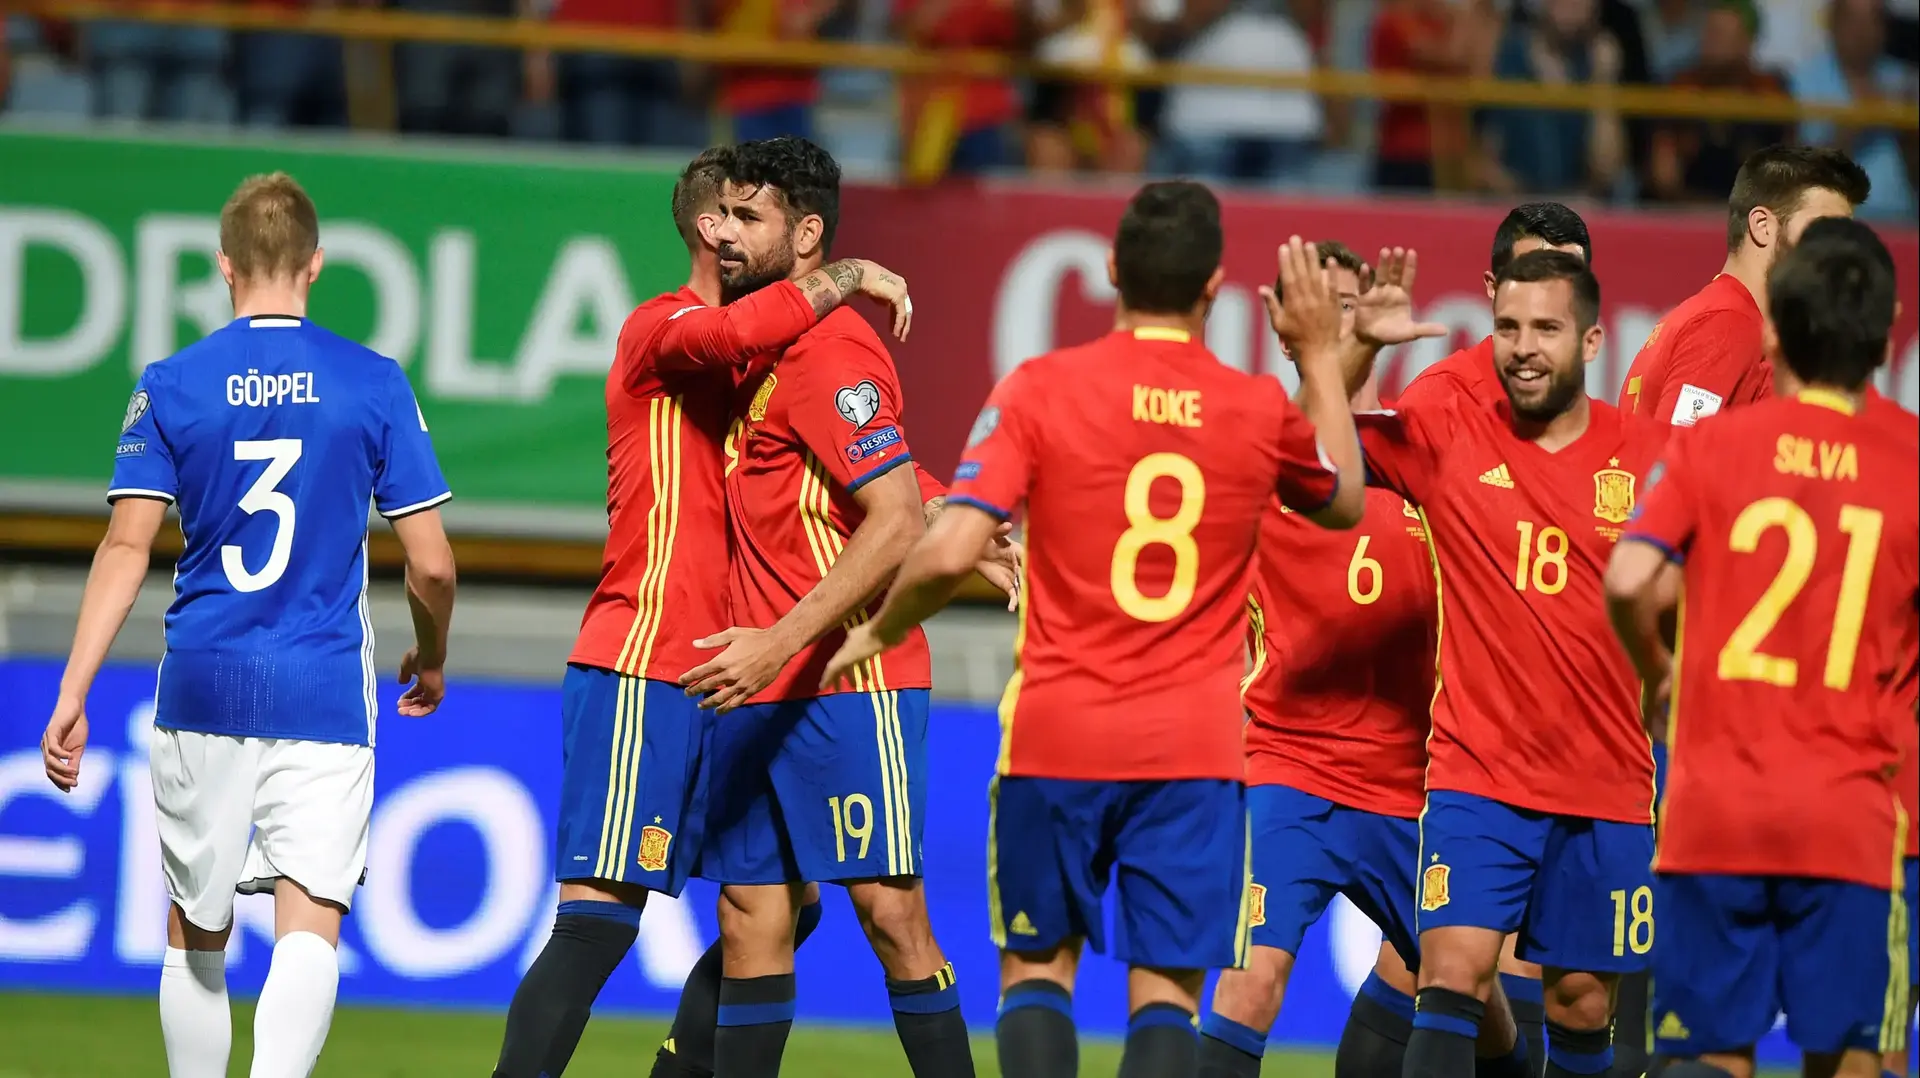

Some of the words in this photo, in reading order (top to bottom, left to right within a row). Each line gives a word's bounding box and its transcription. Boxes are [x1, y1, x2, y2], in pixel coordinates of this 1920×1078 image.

[227, 368, 320, 407] GÖPPEL
[1132, 384, 1202, 428] KOKE
[860, 429, 898, 452] RESPECT
[1773, 433, 1859, 481] SILVA
[221, 438, 303, 593] 3
[1110, 452, 1206, 623] 8
[1347, 535, 1383, 605] 6
[1515, 520, 1569, 595] 18
[1717, 496, 1884, 692] 21
[828, 792, 874, 863] 19
[1610, 885, 1656, 957] 18
